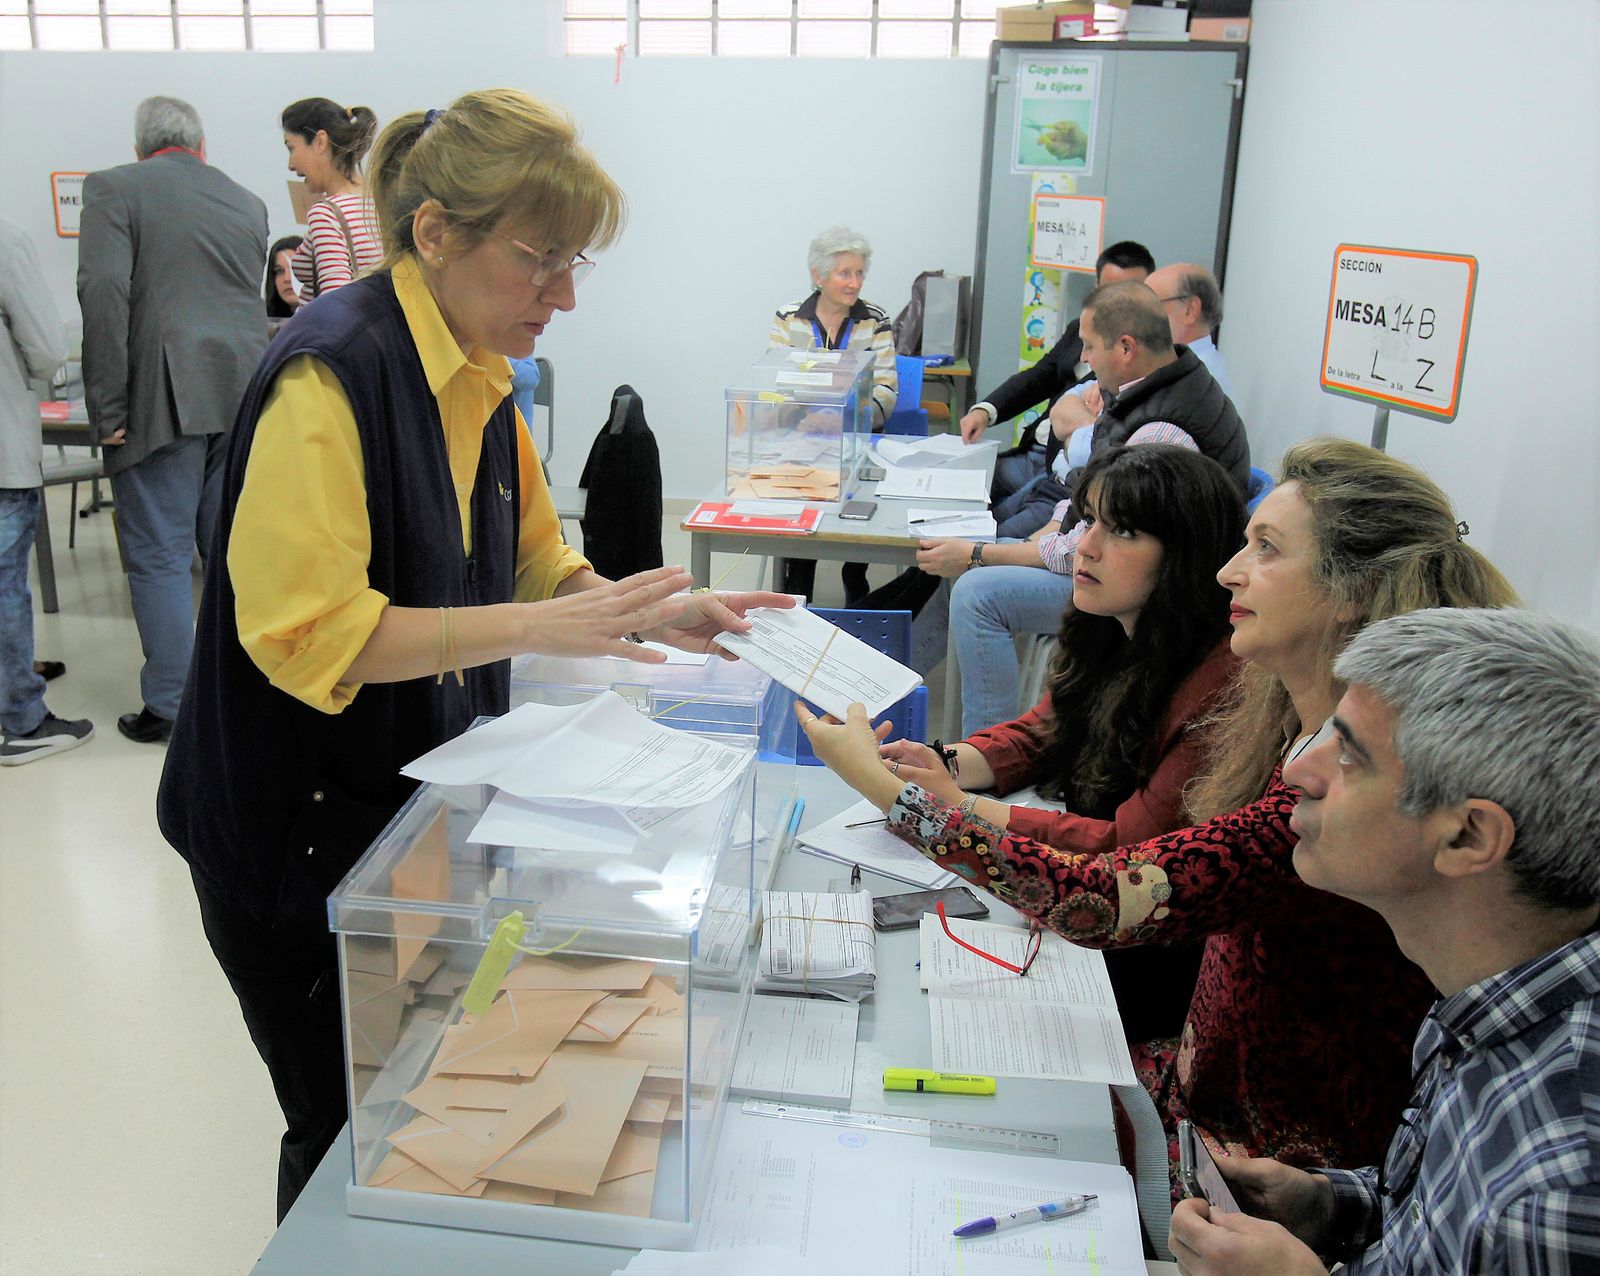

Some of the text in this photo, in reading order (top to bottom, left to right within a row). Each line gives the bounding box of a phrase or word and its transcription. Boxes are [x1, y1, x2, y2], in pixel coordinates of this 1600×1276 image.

[1028, 64, 1088, 76] Coge bien
[1035, 81, 1082, 93] la tijera
[60, 196, 80, 206] ME
[1037, 220, 1064, 233] MESA
[1079, 223, 1087, 237] A
[1055, 243, 1089, 261] A J
[1335, 299, 1436, 339] MESA 14 B
[1327, 366, 1336, 375] De
[1337, 368, 1344, 378] la
[1345, 370, 1360, 380] letra
[1370, 349, 1387, 381] L
[1396, 381, 1404, 391] la
[1414, 358, 1435, 392] Z
